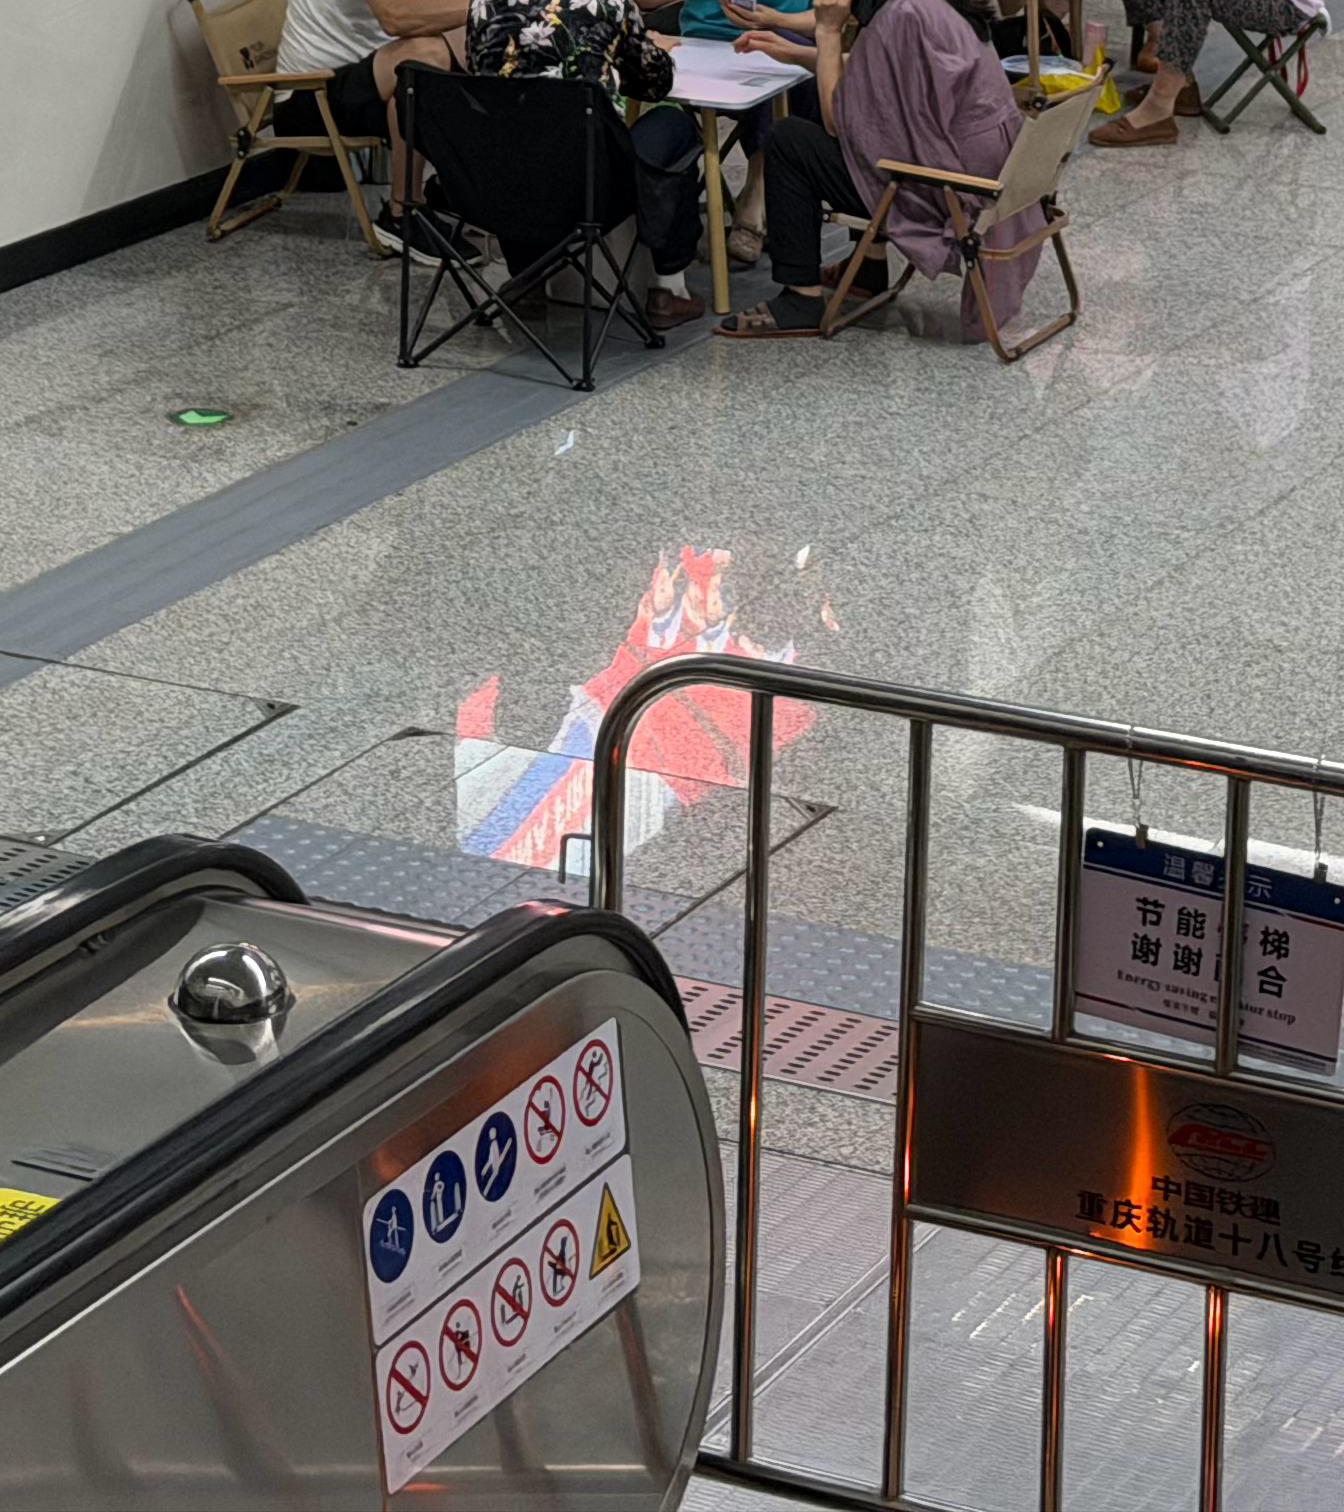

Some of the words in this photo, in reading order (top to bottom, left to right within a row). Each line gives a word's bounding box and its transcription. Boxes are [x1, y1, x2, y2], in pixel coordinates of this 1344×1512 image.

[1162, 852, 1272, 900] 温馨示
[1136, 896, 1291, 961] 节能梯
[1131, 933, 1288, 998] 谢谢合
[1267, 1008, 1296, 1025] stop
